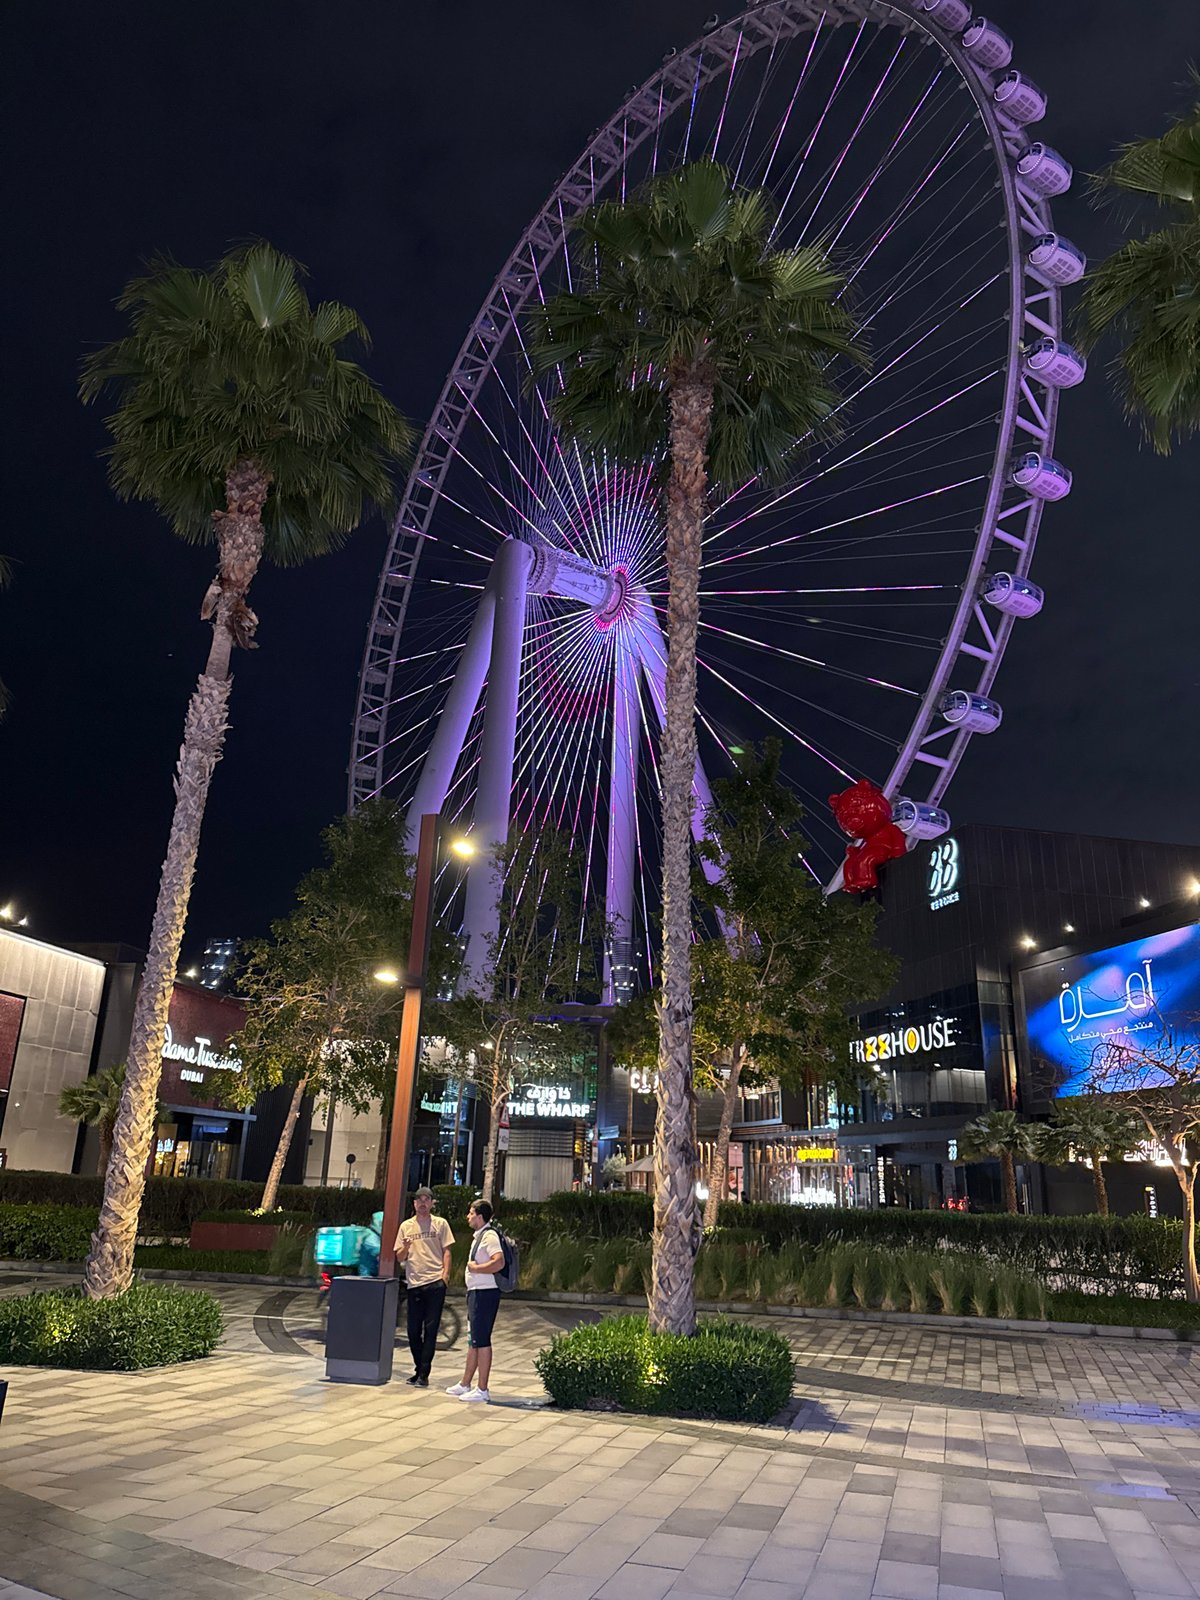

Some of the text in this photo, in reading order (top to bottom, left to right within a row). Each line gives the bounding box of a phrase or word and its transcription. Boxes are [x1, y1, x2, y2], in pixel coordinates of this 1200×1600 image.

[1123, 1021, 1154, 1035] منتجع
[1067, 1031, 1100, 1044] متكامل
[180, 1069, 204, 1083] DUBAI
[506, 1101, 590, 1117] THE WHARF
